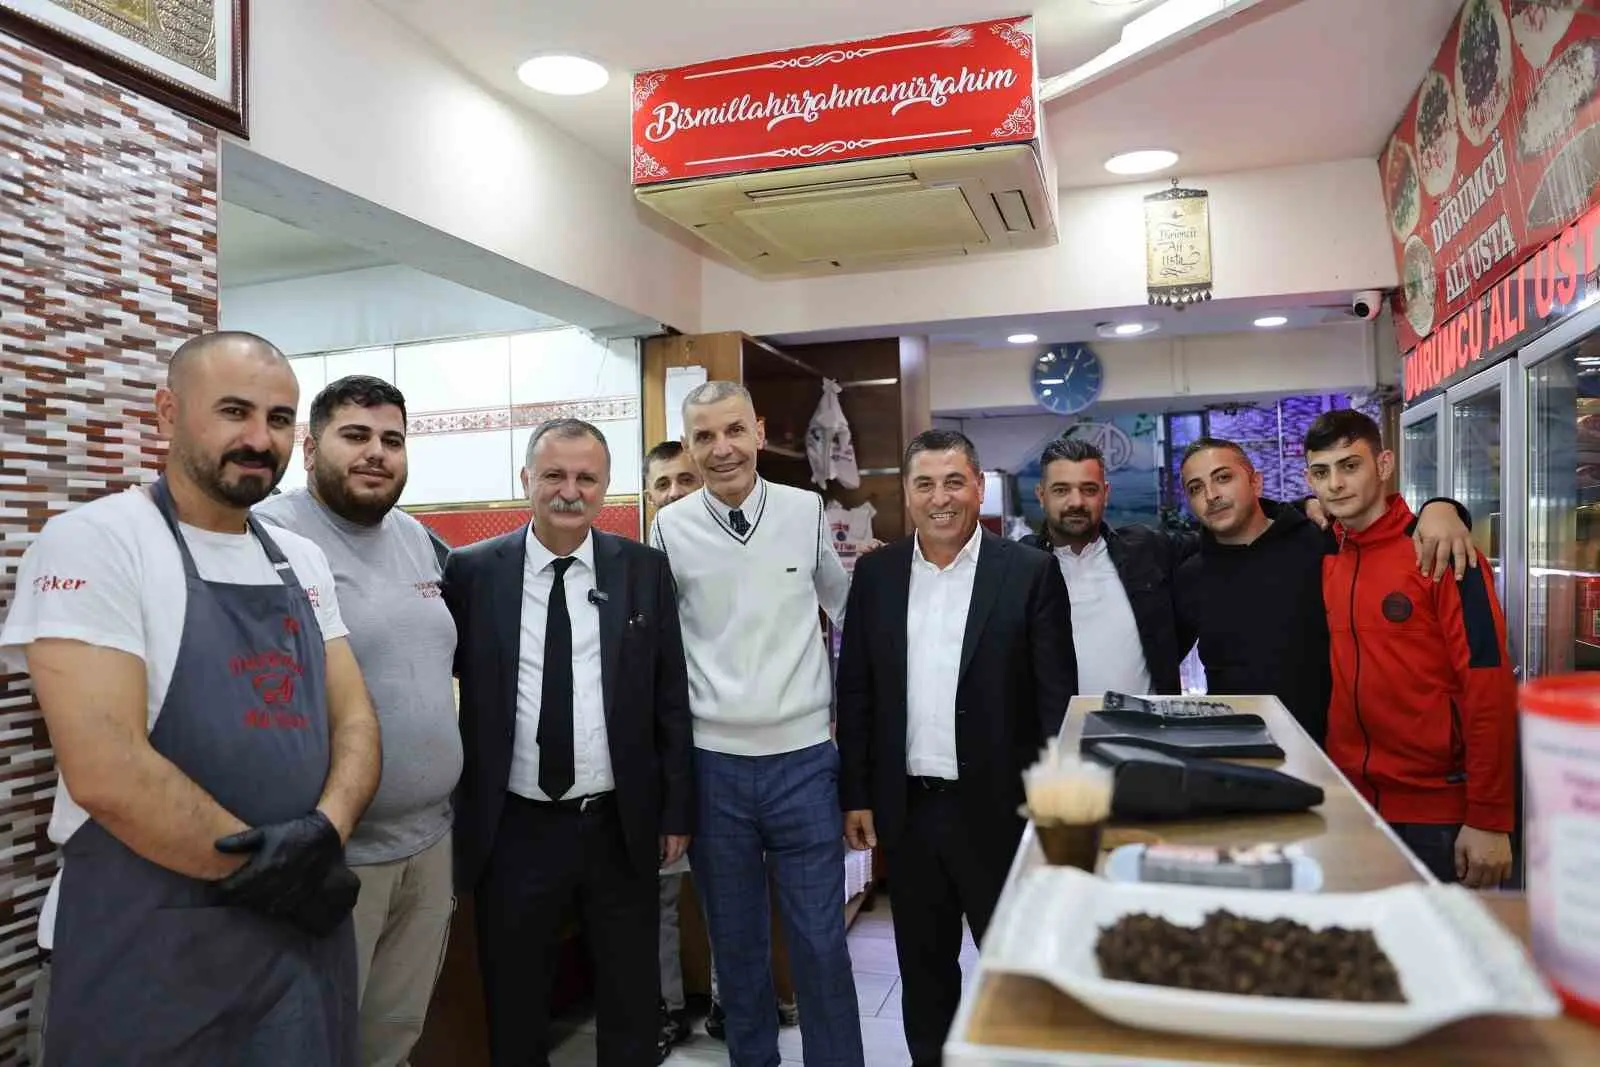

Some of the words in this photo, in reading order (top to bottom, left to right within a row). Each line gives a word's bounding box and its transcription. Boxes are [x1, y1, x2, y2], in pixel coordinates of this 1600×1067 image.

[645, 67, 1017, 143] Bismillahirrahmanirrahim
[1430, 130, 1507, 253] DÜRÜMCÜ
[1468, 213, 1517, 281] USTA
